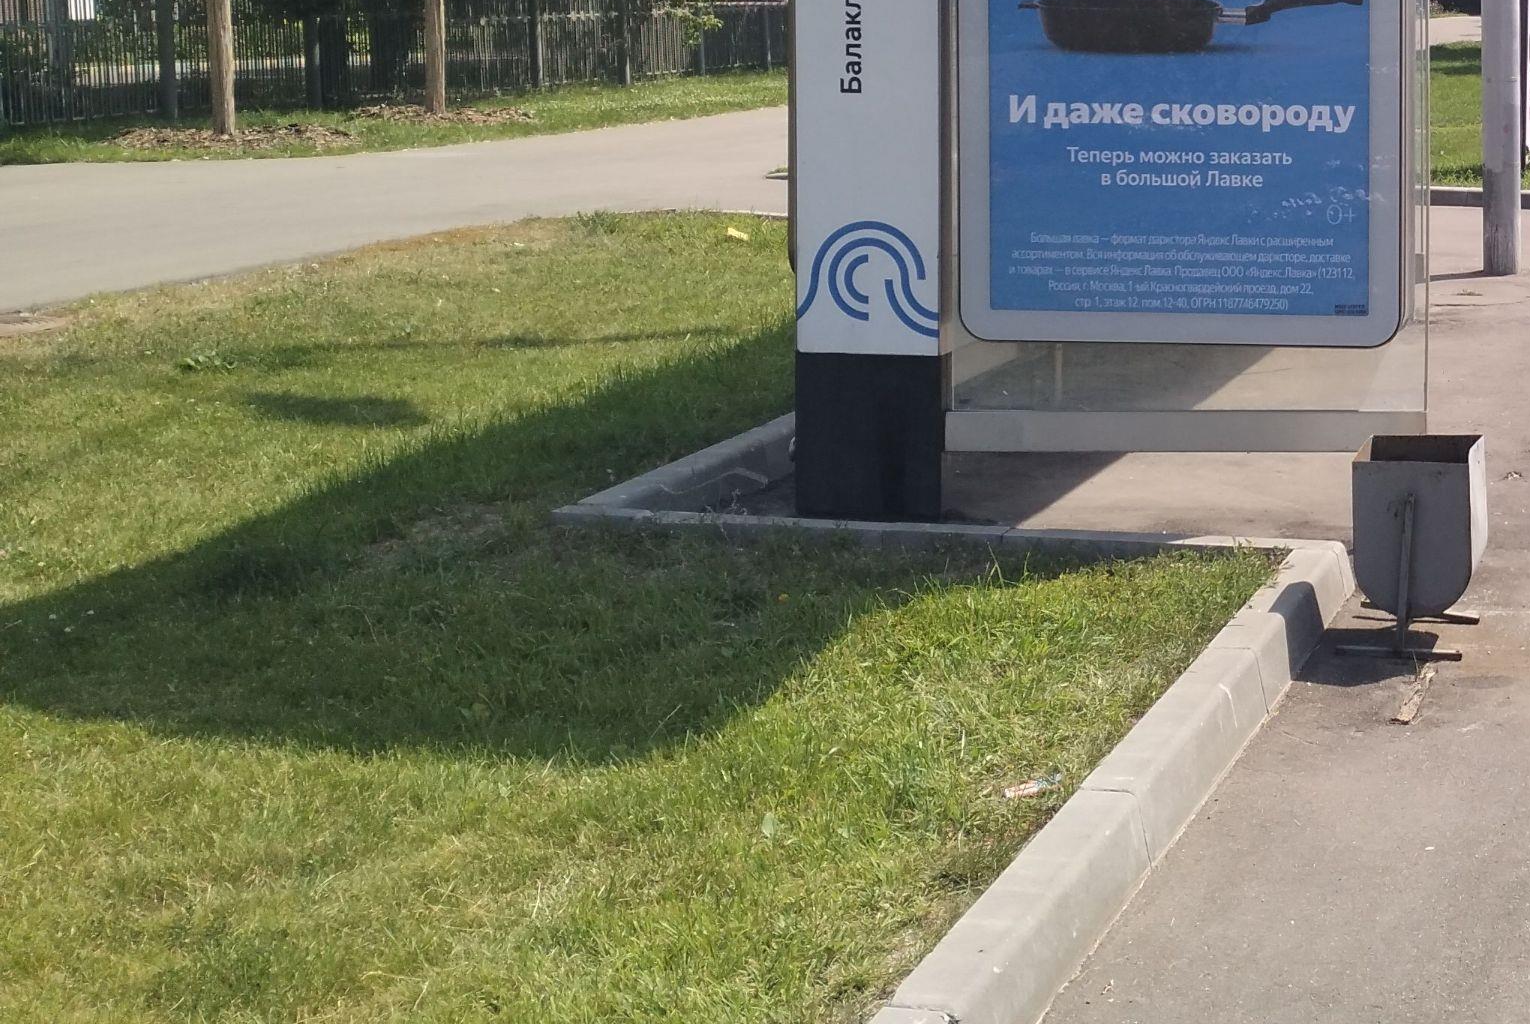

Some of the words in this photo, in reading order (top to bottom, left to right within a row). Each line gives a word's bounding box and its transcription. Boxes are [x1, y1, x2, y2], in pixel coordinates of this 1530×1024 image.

[1009, 94, 1036, 123] И
[1043, 102, 1144, 129] даже
[1150, 103, 1356, 133] сковороду
[1066, 147, 1135, 166] Теперь
[1139, 151, 1205, 164] можно
[1208, 151, 1293, 165] заказать
[1101, 173, 1112, 186] в
[1116, 169, 1201, 187] большой
[1206, 171, 1264, 188] Лавке
[1327, 204, 1355, 225] 0+
[1266, 237, 1334, 248] расширенным
